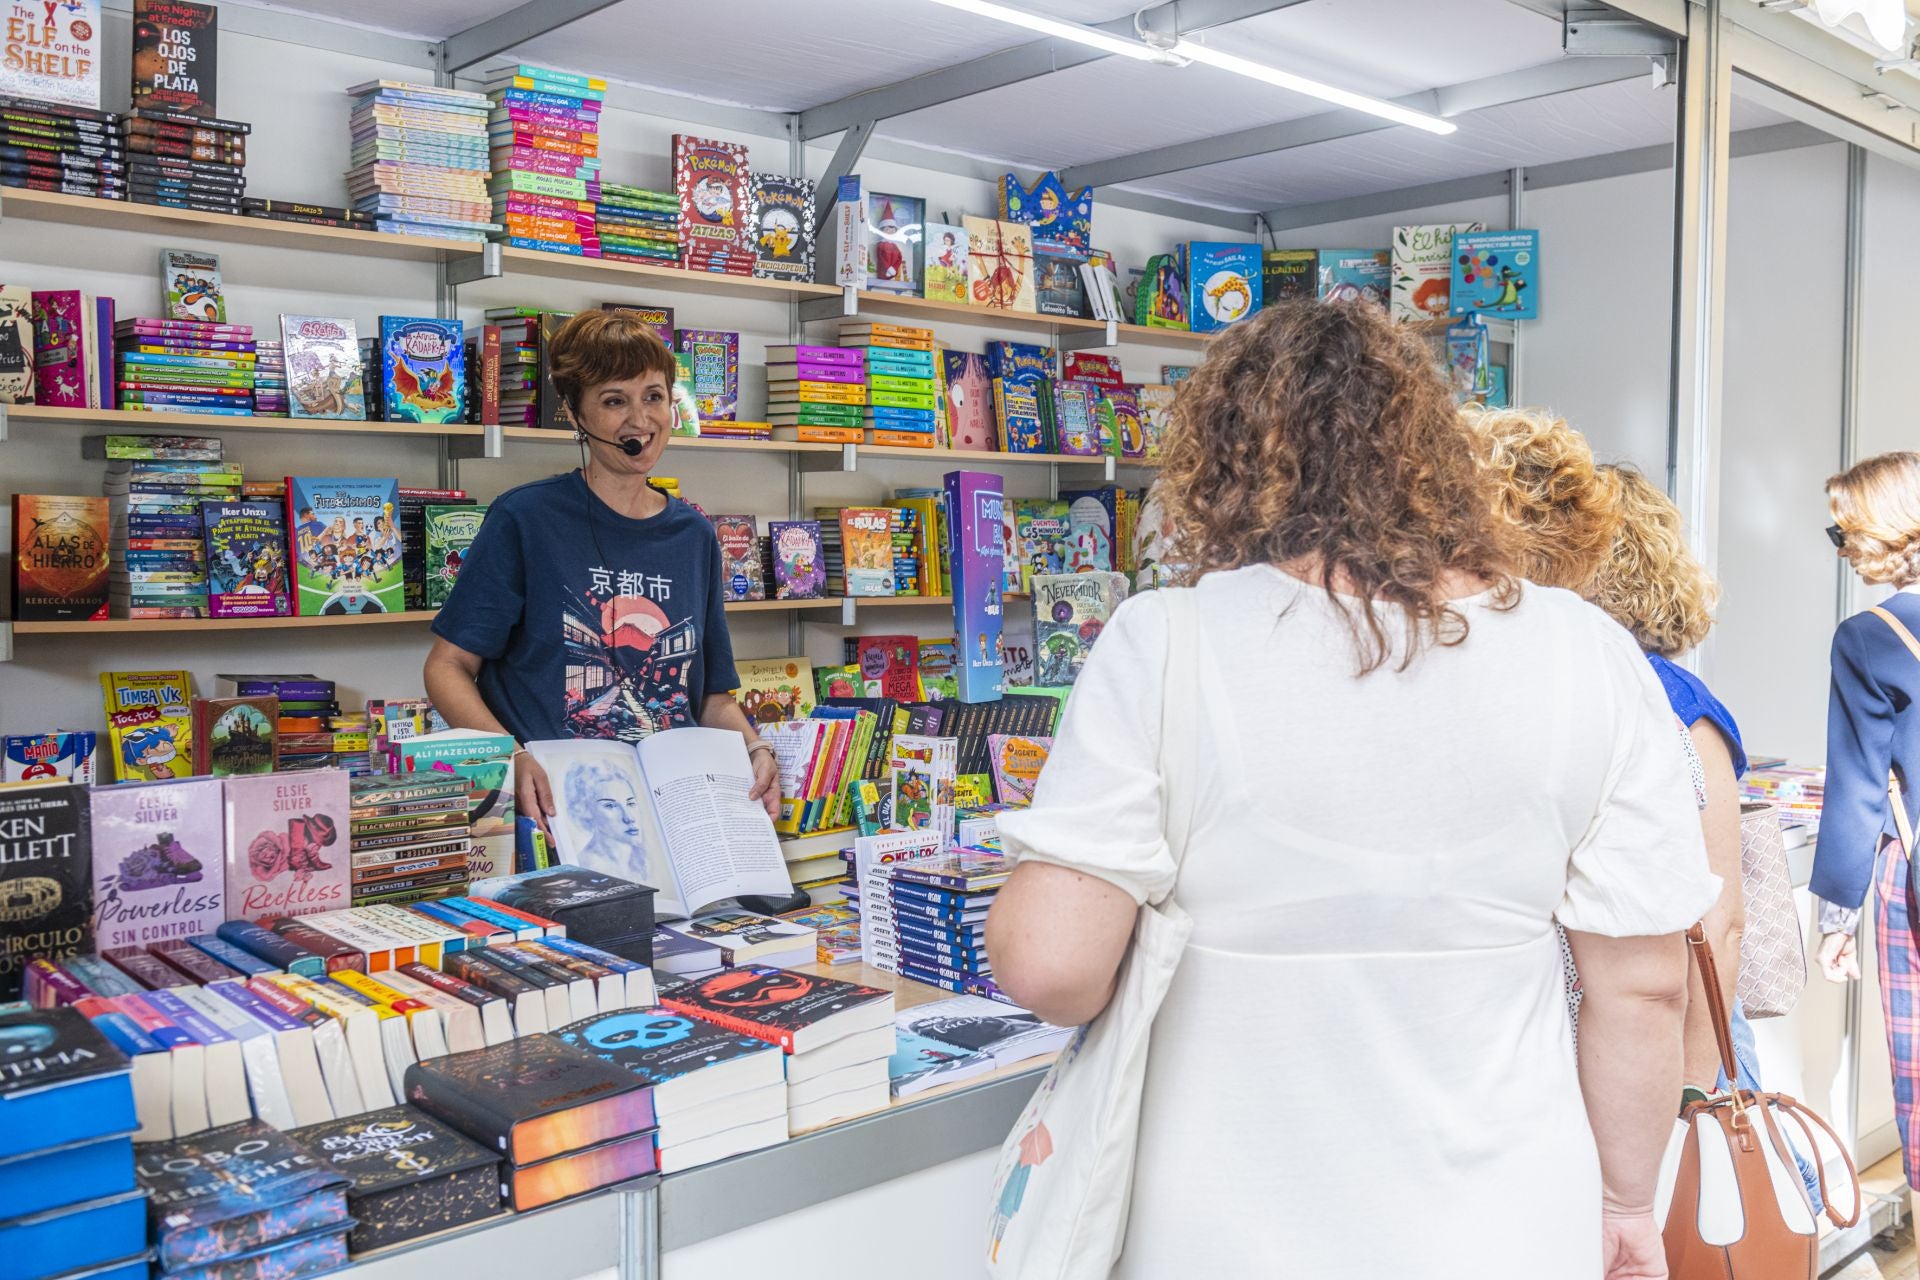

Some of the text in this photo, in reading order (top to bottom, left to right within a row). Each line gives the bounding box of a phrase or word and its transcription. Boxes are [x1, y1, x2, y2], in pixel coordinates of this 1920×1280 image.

[12, 6, 34, 19] The
[148, 2, 168, 12] Five
[149, 14, 159, 22] at
[7, 17, 57, 49] ELF
[163, 28, 190, 45] LOS
[55, 43, 90, 56] on the
[158, 43, 196, 61] OJOS
[2, 43, 91, 79] SHELF
[168, 60, 187, 75] DE
[154, 74, 198, 92] PLATA
[555, 188, 573, 196] MUCHO
[690, 223, 735, 242] ATLAS
[1413, 230, 1430, 250] El
[755, 261, 807, 274] ENCICLOPEDIA
[222, 508, 266, 516] Iker Unzu
[854, 517, 886, 530] RULAS
[1032, 519, 1059, 527] CUENTOS
[1031, 528, 1038, 538] 5
[33, 535, 95, 550] ALAS DE
[33, 554, 97, 569] HIERRO
[588, 566, 672, 602] 京都市
[1042, 580, 1104, 606] NEVERMOOR
[25, 597, 66, 605] REBECCA
[118, 686, 183, 707] TIMBA VK
[24, 743, 60, 760] MARIO
[218, 751, 270, 767] Harry Potter
[415, 746, 501, 759] ALI HAZELWOOD
[706, 774, 715, 783] N
[276, 784, 308, 797] ELSIE
[654, 788, 661, 797] N
[40, 800, 68, 809] TIERRA
[273, 797, 312, 812] SILVER
[135, 808, 178, 823] SILVER
[360, 821, 407, 831] BLACKWATER
[361, 837, 404, 846] BLACKWATER
[363, 884, 405, 893] BLACKWATER
[241, 880, 342, 914] Reckless
[96, 887, 221, 930] Powerless
[112, 920, 204, 944] SIN CONTROL
[757, 983, 855, 1022] DE RODILLAS
[558, 1013, 613, 1034] NAVESSA
[624, 1030, 740, 1072] A OSCURAS
[331, 1130, 434, 1163] ACADEMY
